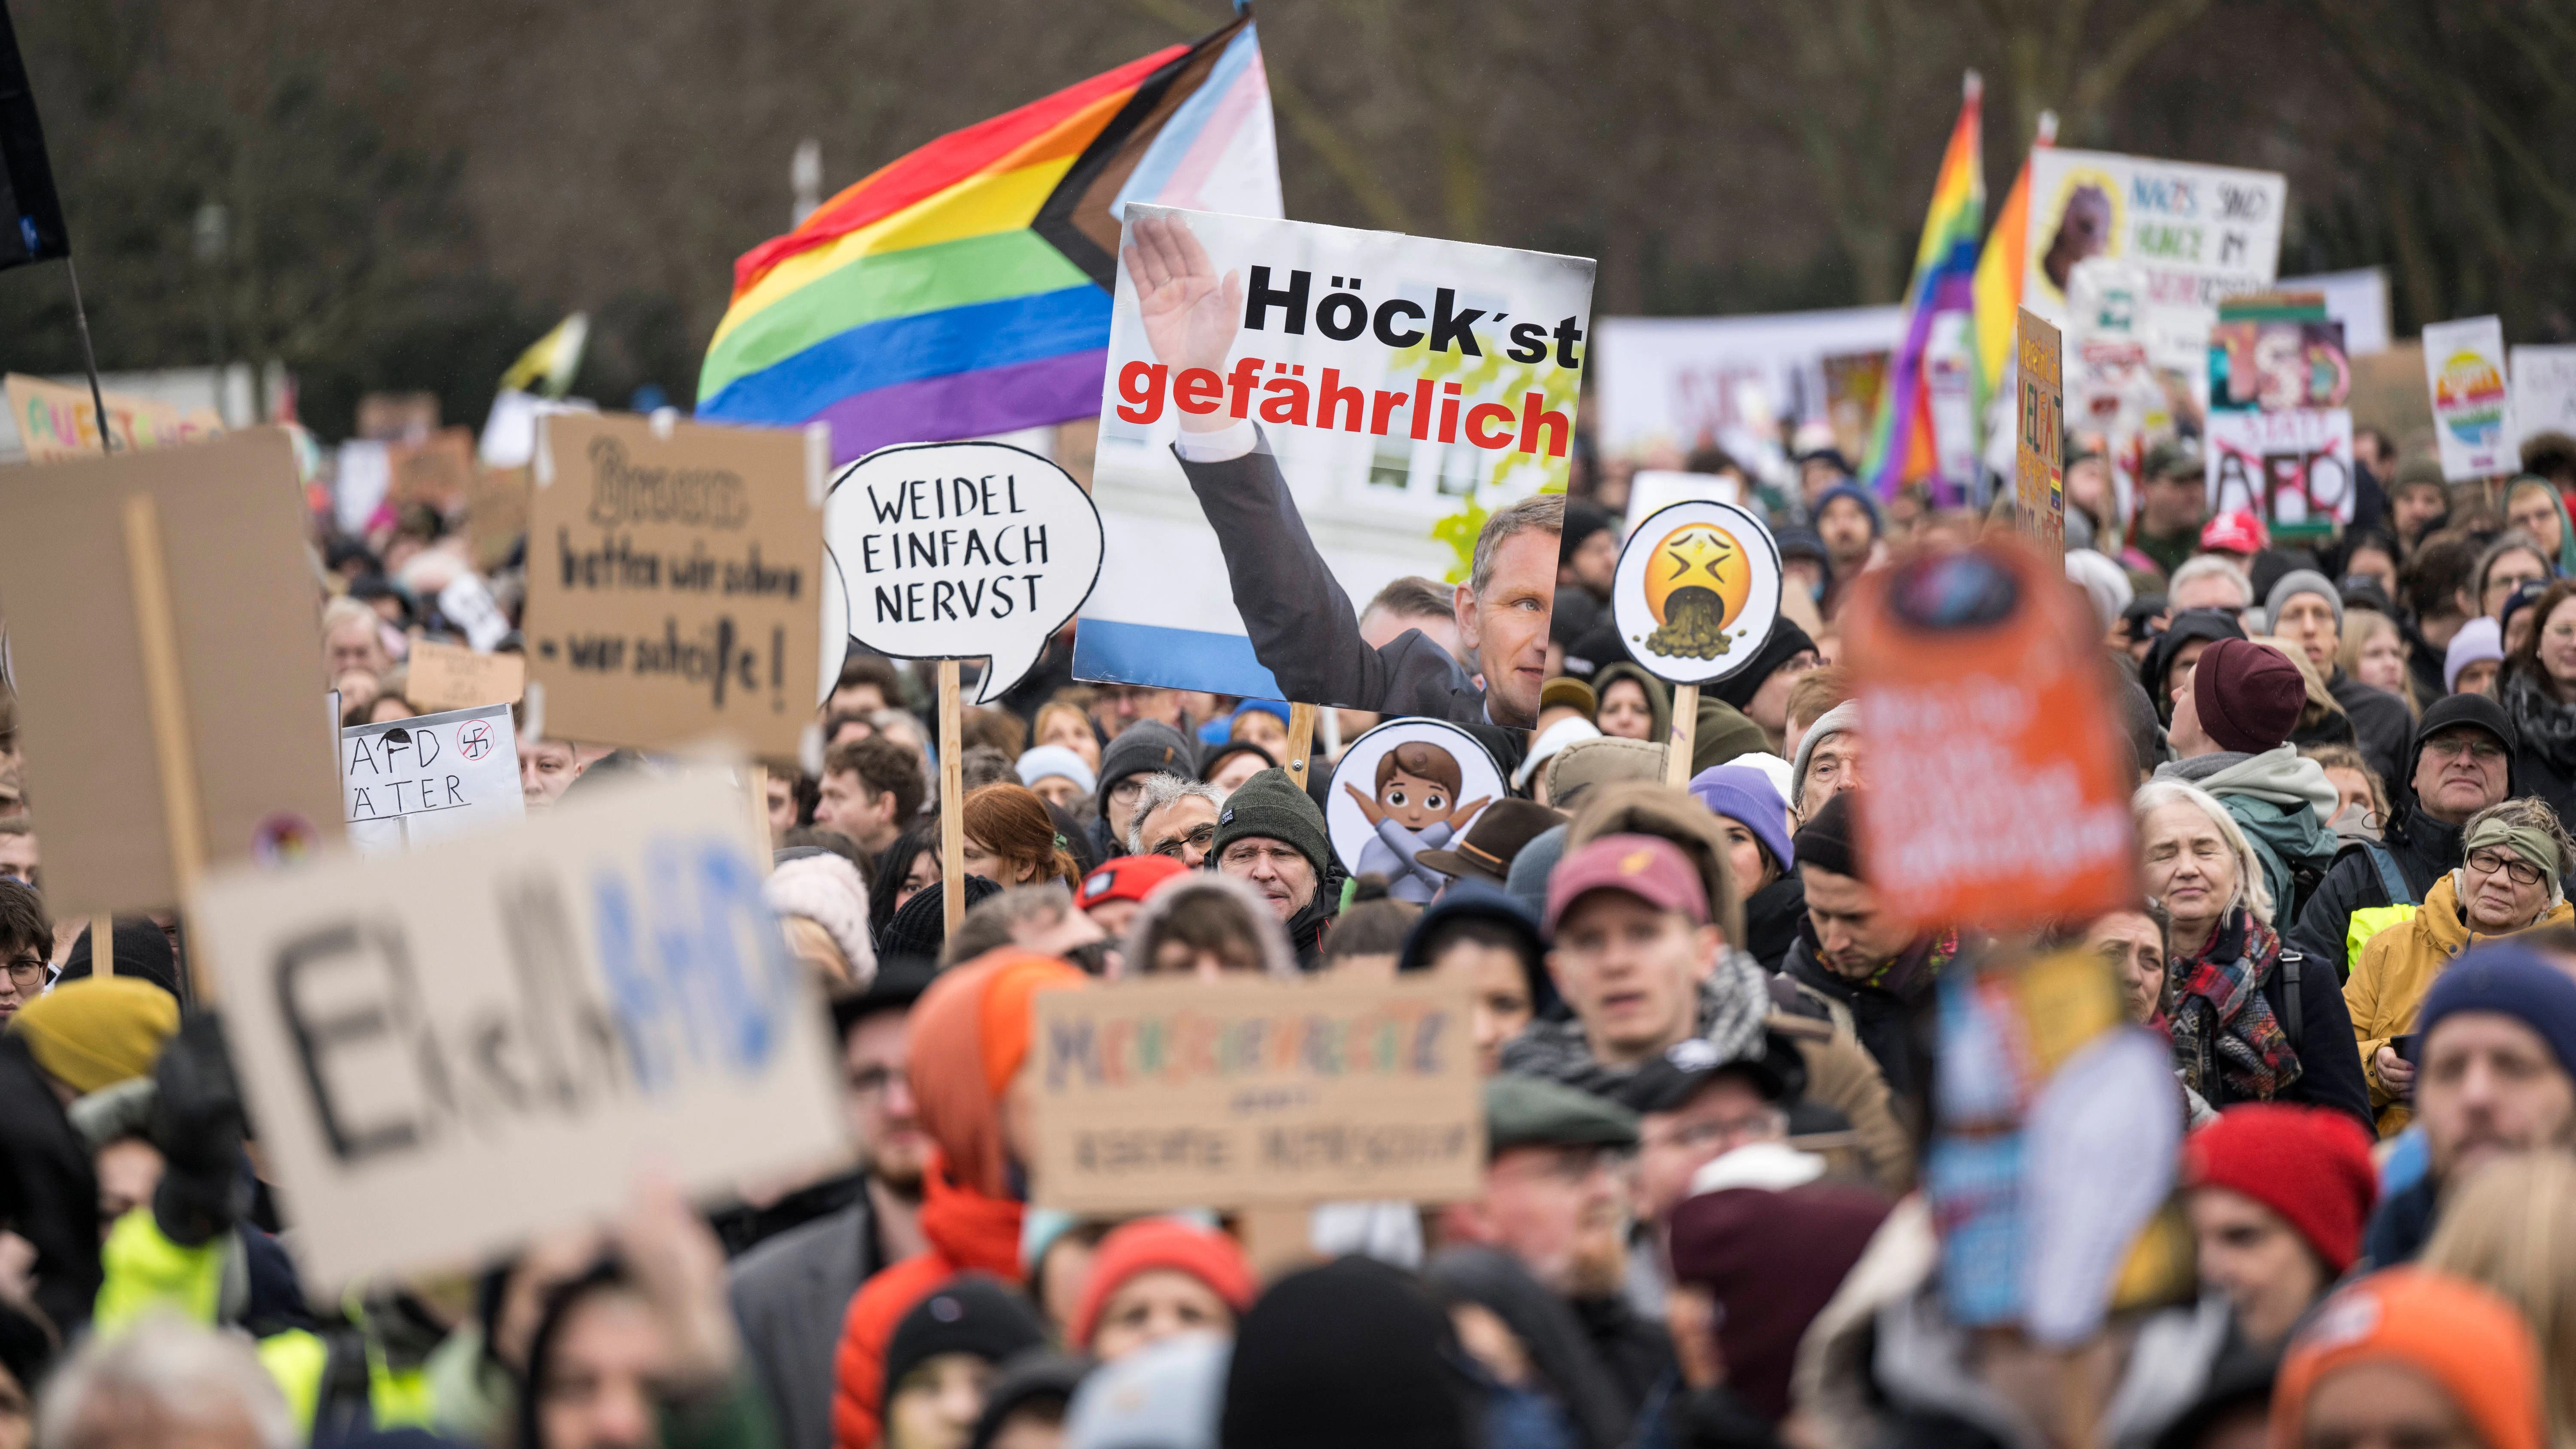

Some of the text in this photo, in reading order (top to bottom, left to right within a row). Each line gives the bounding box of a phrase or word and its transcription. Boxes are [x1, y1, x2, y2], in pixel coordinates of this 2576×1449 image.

[2017, 316, 2049, 381] Vereint
[1117, 357, 1570, 457] gefährlich
[2018, 442, 2048, 501] gegen
[867, 475, 1027, 524] WEIDEL
[863, 524, 1048, 573] EINFACH
[875, 574, 1043, 623] NERVST
[353, 775, 464, 818] ÄTER
[1222, 808, 1232, 819] DOWN
[1222, 814, 1233, 824] LOAD
